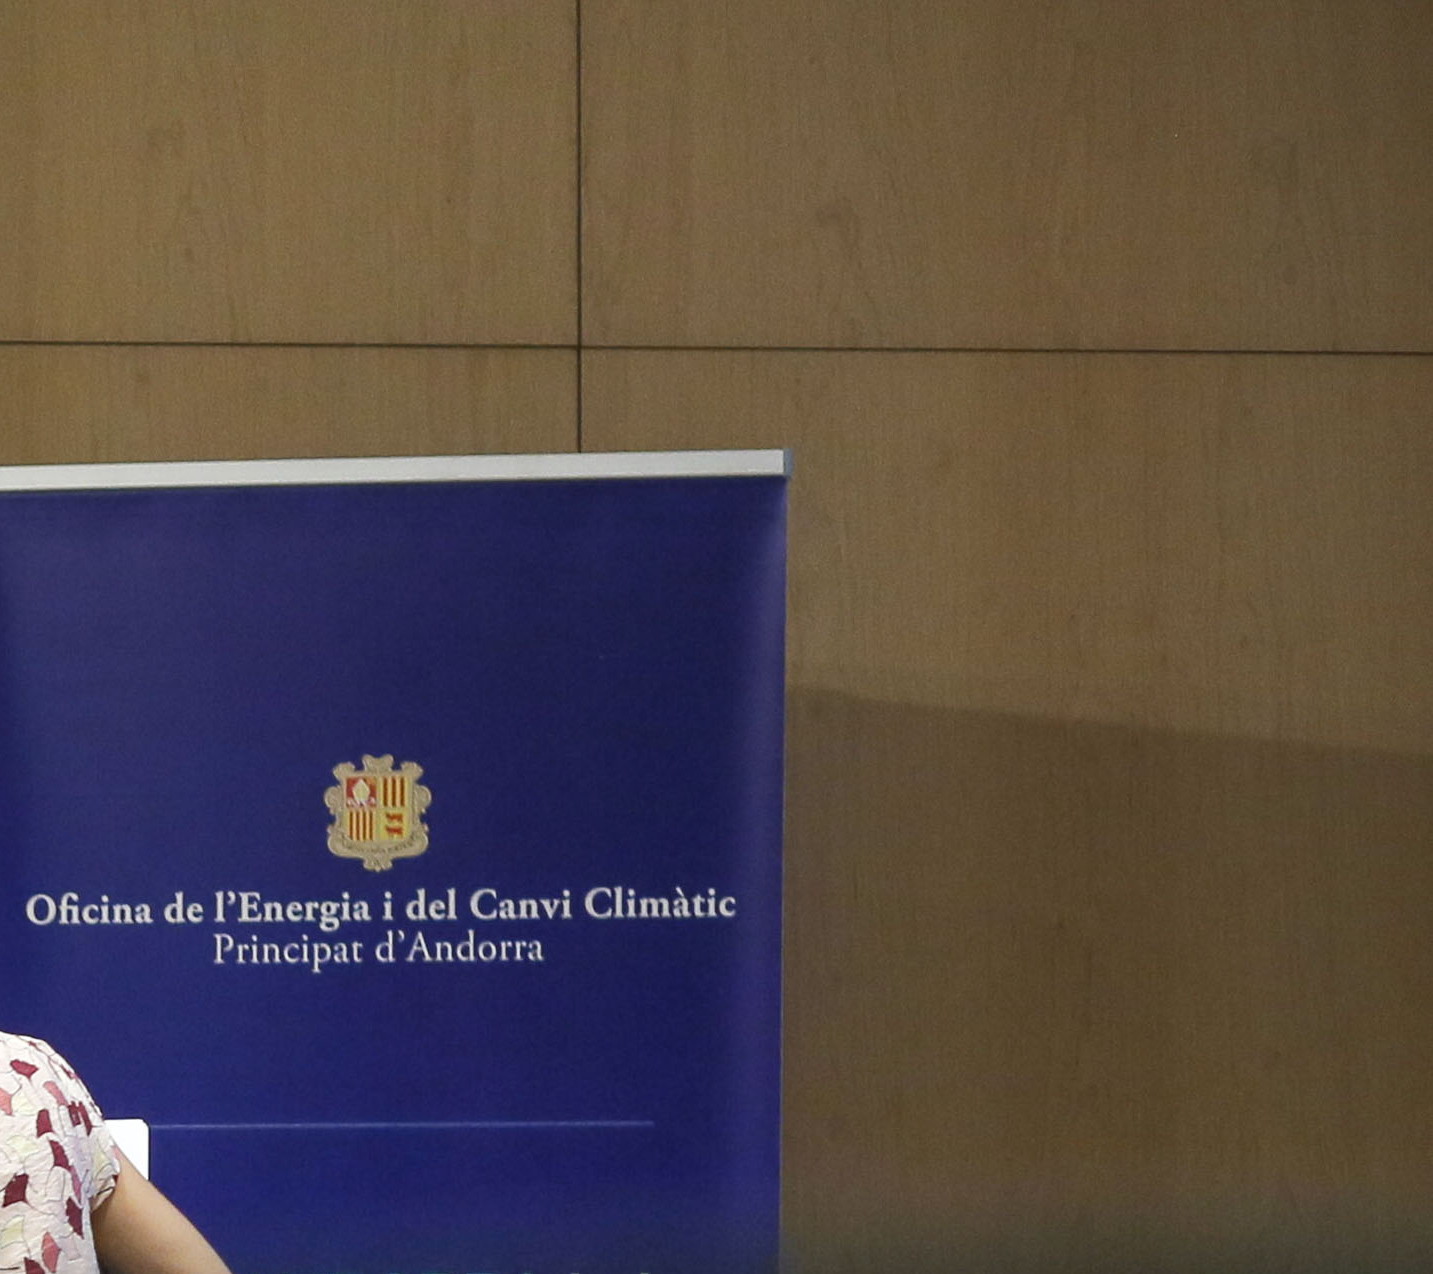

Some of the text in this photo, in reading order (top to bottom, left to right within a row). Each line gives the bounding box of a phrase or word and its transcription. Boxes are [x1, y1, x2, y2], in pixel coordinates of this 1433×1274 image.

[25, 886, 737, 932] Oficina de l’Energia i del Canvi Climàtic
[213, 929, 545, 974] Principat d’Andorra
